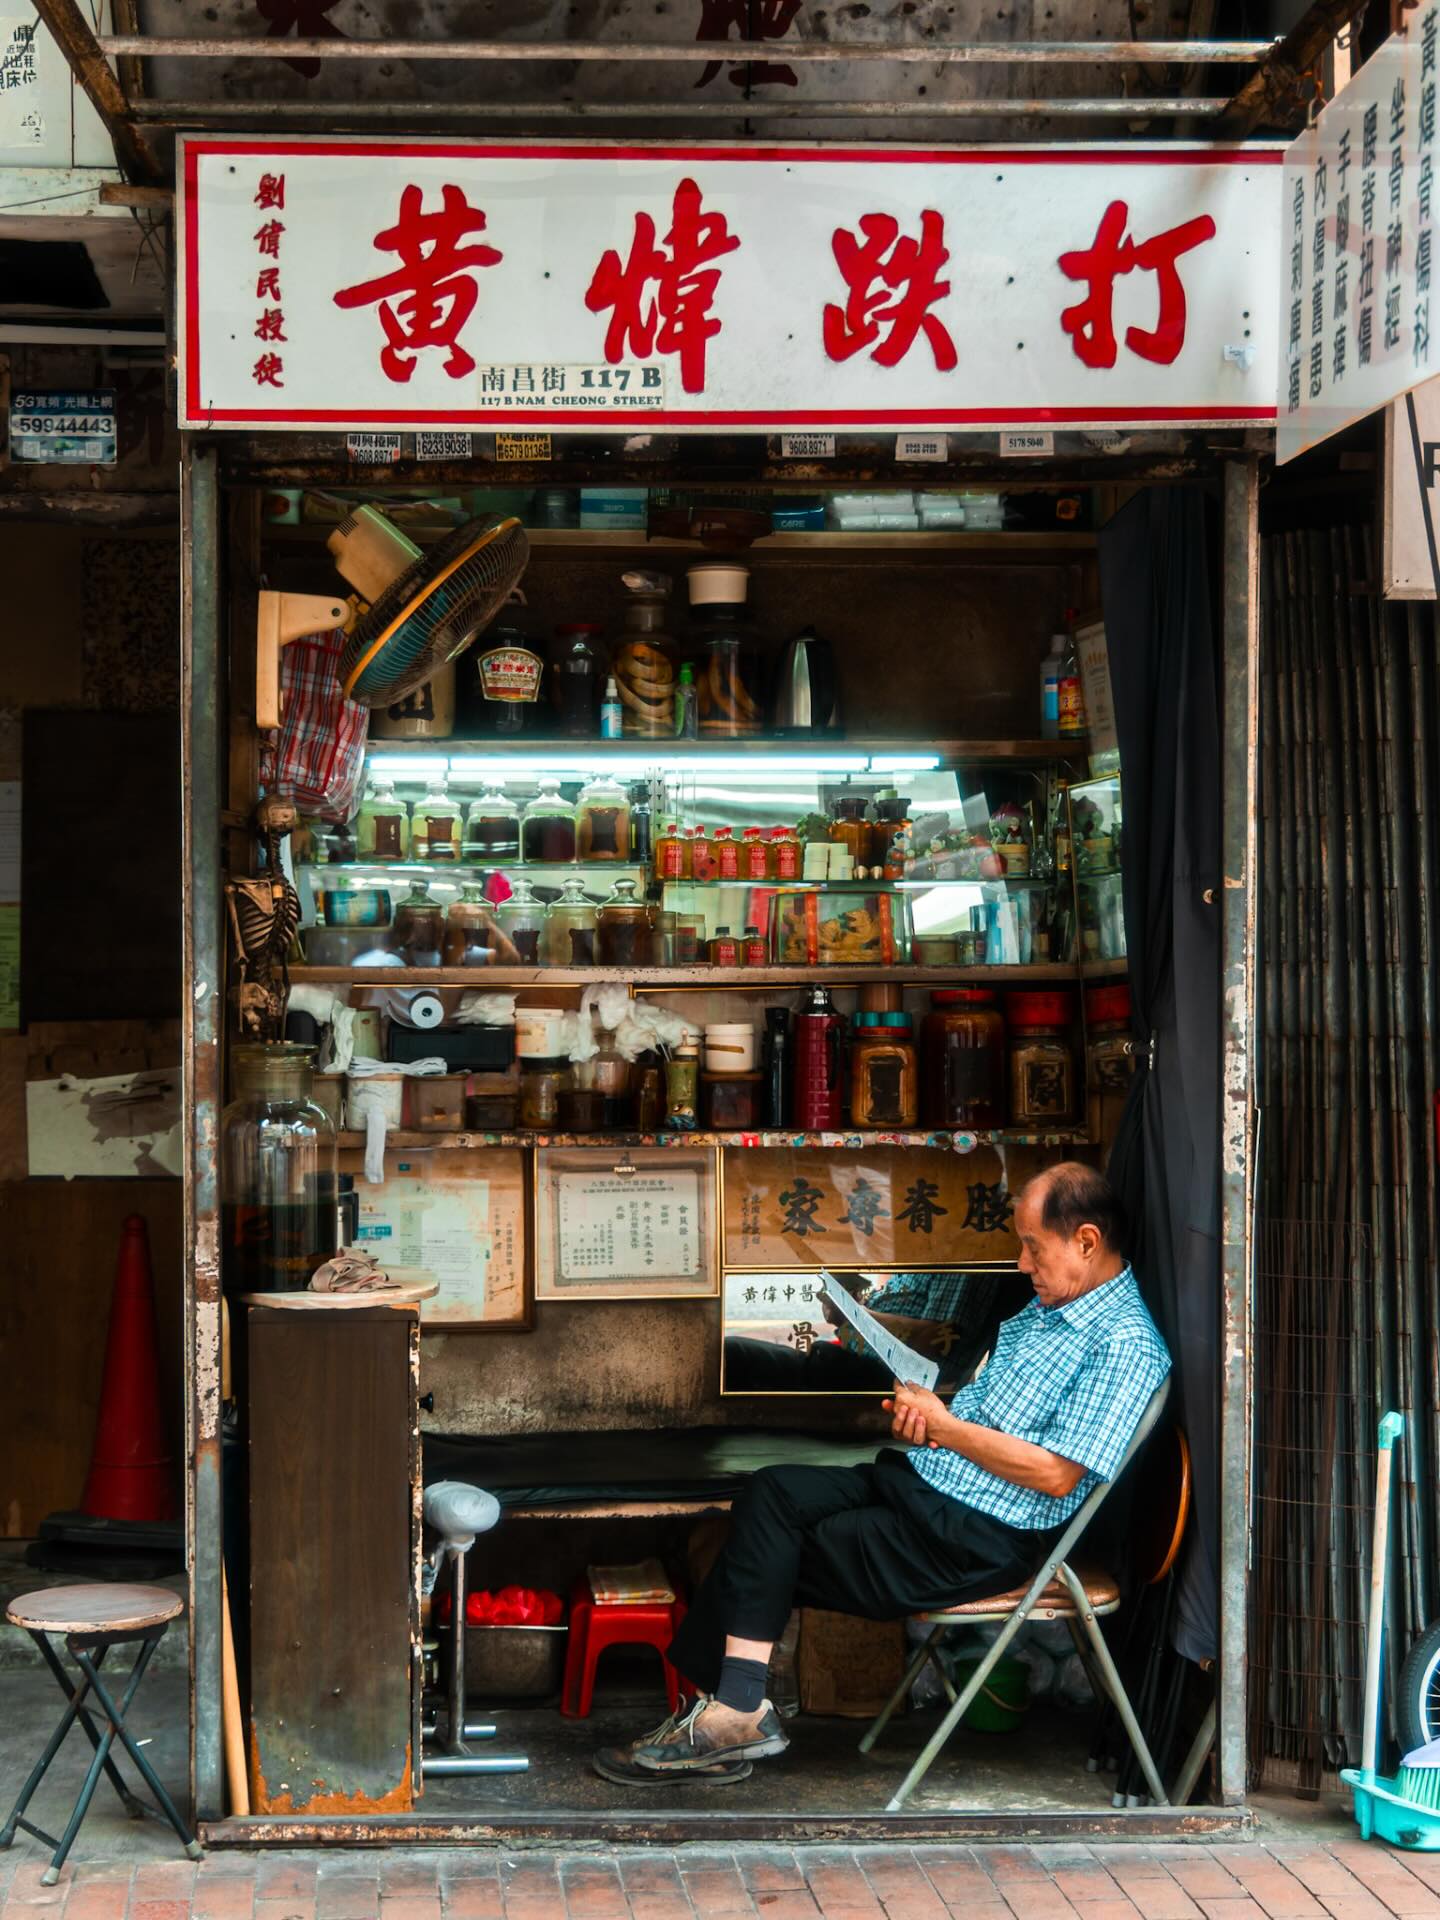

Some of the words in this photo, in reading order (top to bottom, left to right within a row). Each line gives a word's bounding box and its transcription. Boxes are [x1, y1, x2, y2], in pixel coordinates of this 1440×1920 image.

[481, 366, 565, 392] 南昌街
[580, 368, 630, 390] 117
[641, 368, 662, 388] B
[480, 395, 502, 405] 117
[504, 395, 513, 405] B
[516, 395, 546, 406] NAM
[553, 395, 607, 406] CHEONG
[613, 395, 663, 406] STREET
[19, 418, 112, 434] 59944443
[422, 439, 444, 454] 6233
[445, 439, 466, 454] 9038
[789, 440, 808, 455] 9608
[809, 440, 827, 455] 8971
[1009, 438, 1026, 448] 5178
[1027, 438, 1044, 448] 5040
[504, 444, 523, 459] 6579
[524, 444, 543, 459] 0136
